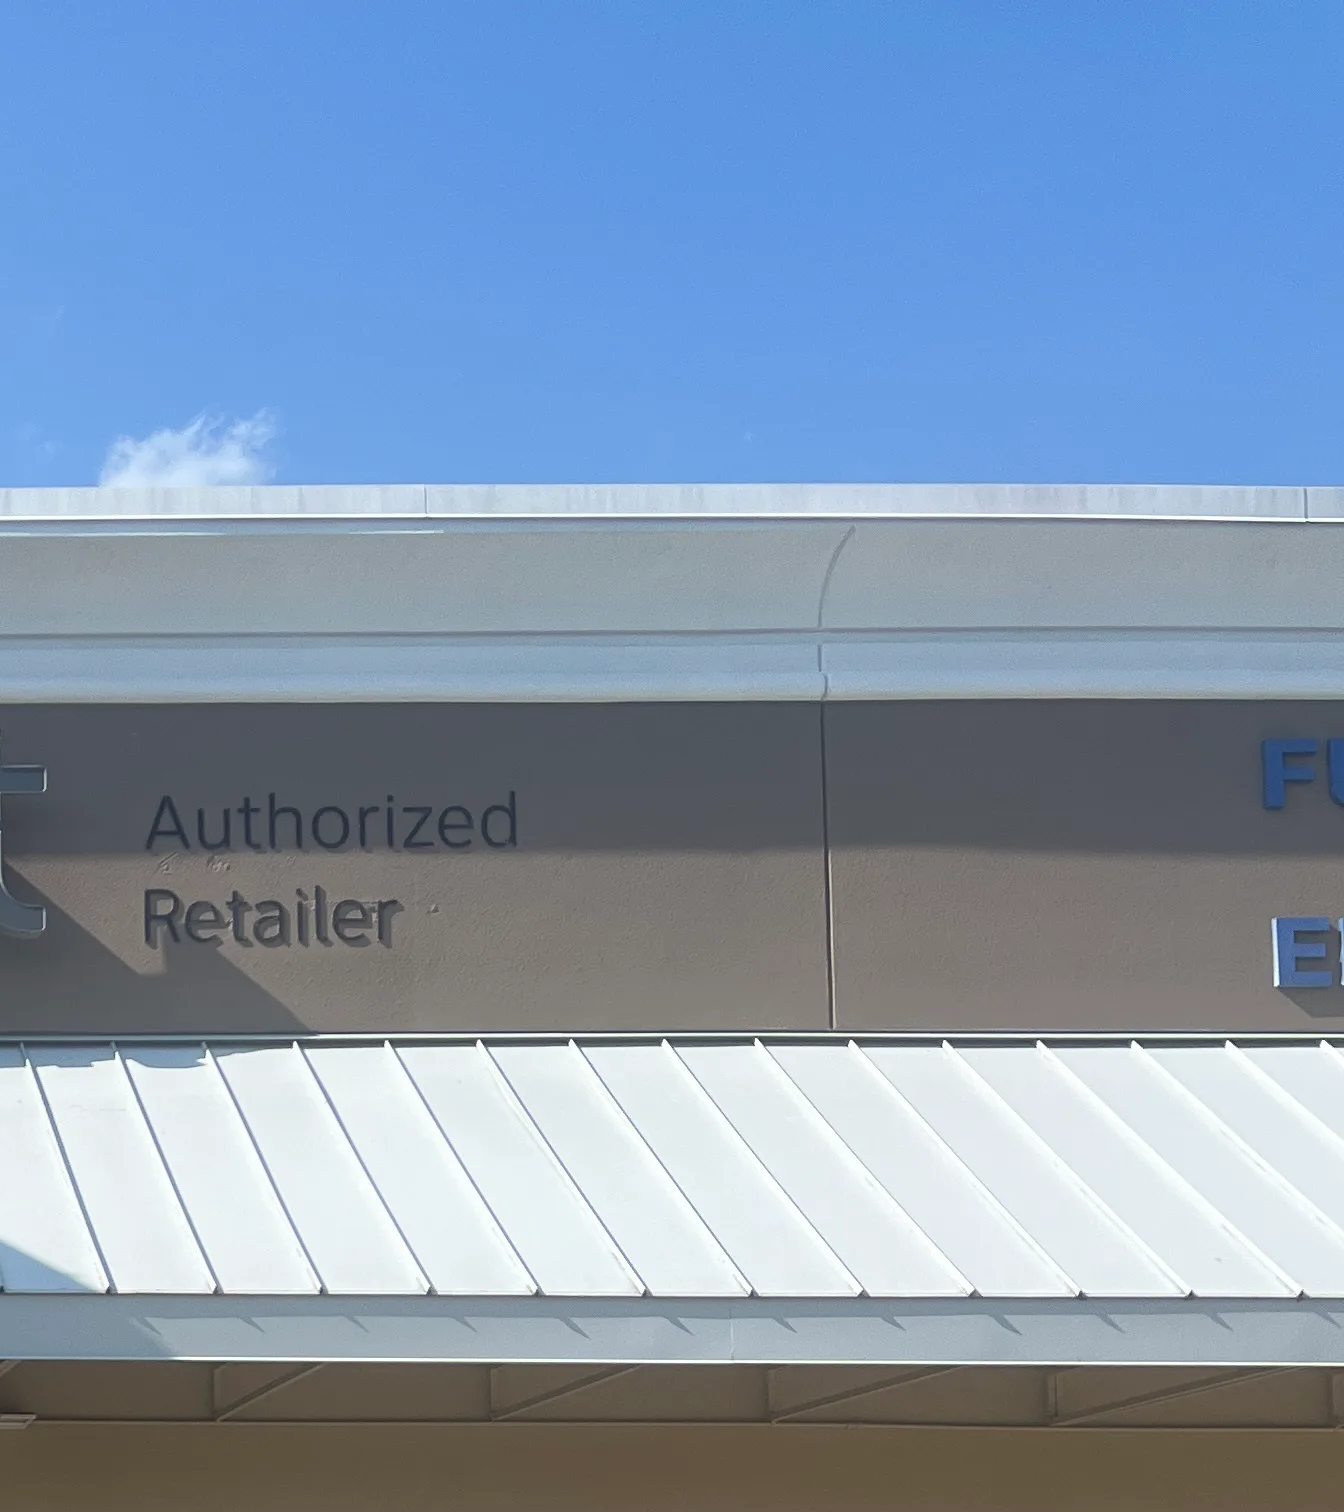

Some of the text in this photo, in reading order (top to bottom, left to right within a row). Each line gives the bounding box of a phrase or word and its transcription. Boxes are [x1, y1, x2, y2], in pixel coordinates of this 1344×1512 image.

[1261, 738, 1344, 810] F
[146, 791, 518, 852] Authorized
[144, 886, 404, 949] Retailer
[1271, 916, 1344, 988] E
